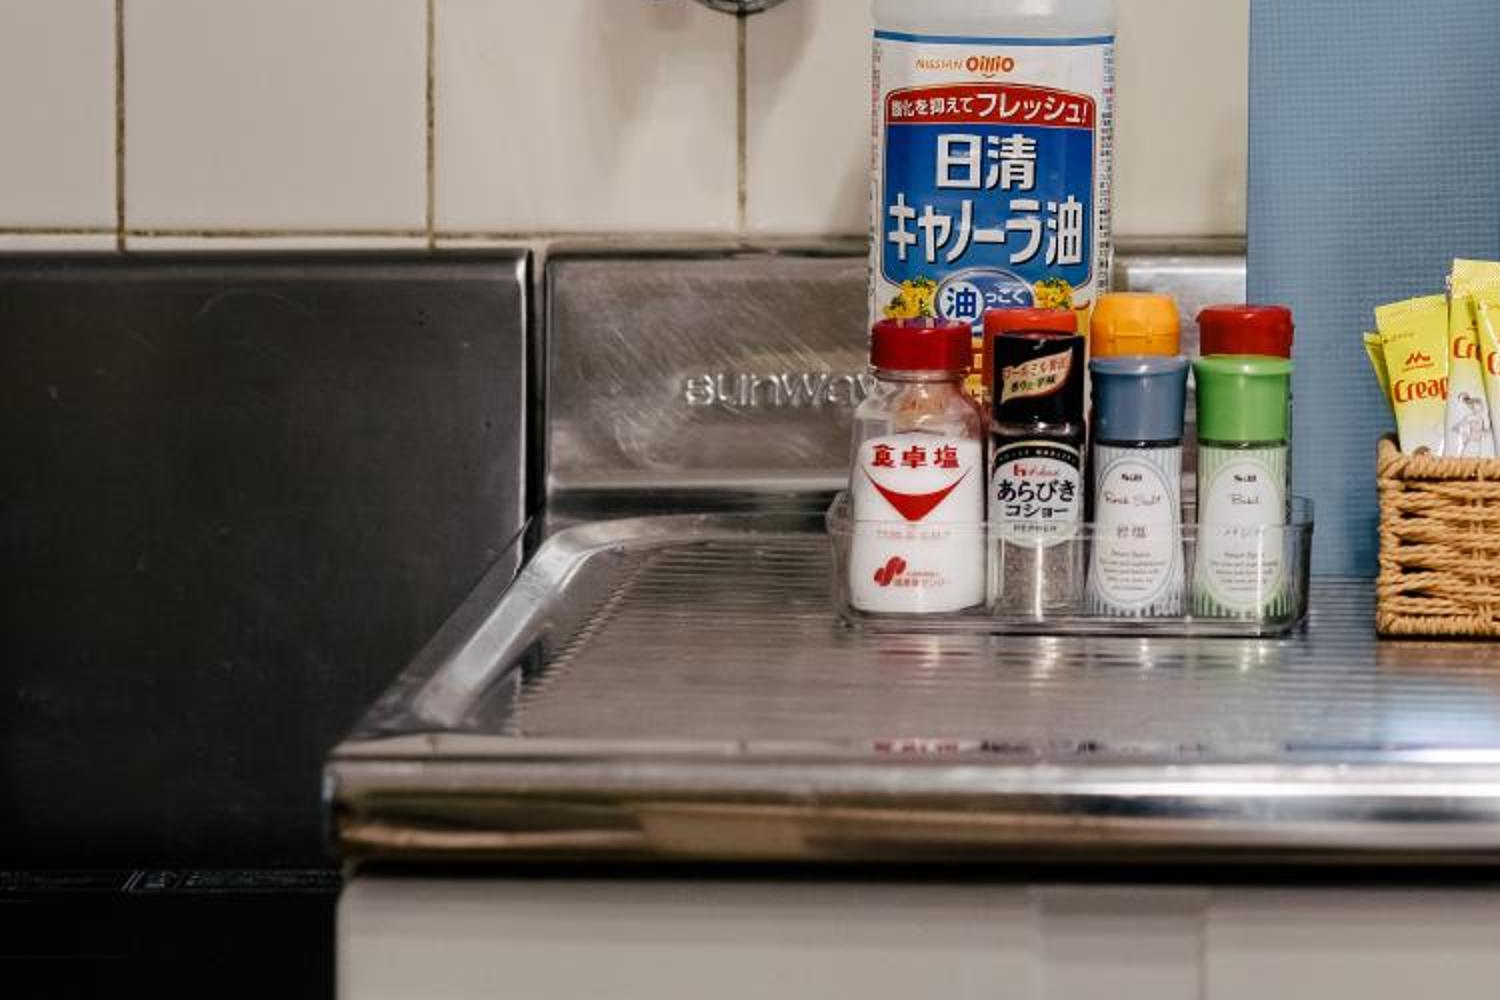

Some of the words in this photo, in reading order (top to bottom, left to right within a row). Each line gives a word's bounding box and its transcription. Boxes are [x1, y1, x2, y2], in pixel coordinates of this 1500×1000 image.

[936, 133, 1038, 192] 日清
[888, 193, 1085, 268] キャノーラ油
[871, 444, 961, 470] 食卓塩
[997, 479, 1076, 503] あらびき
[1005, 503, 1069, 518] コショー
